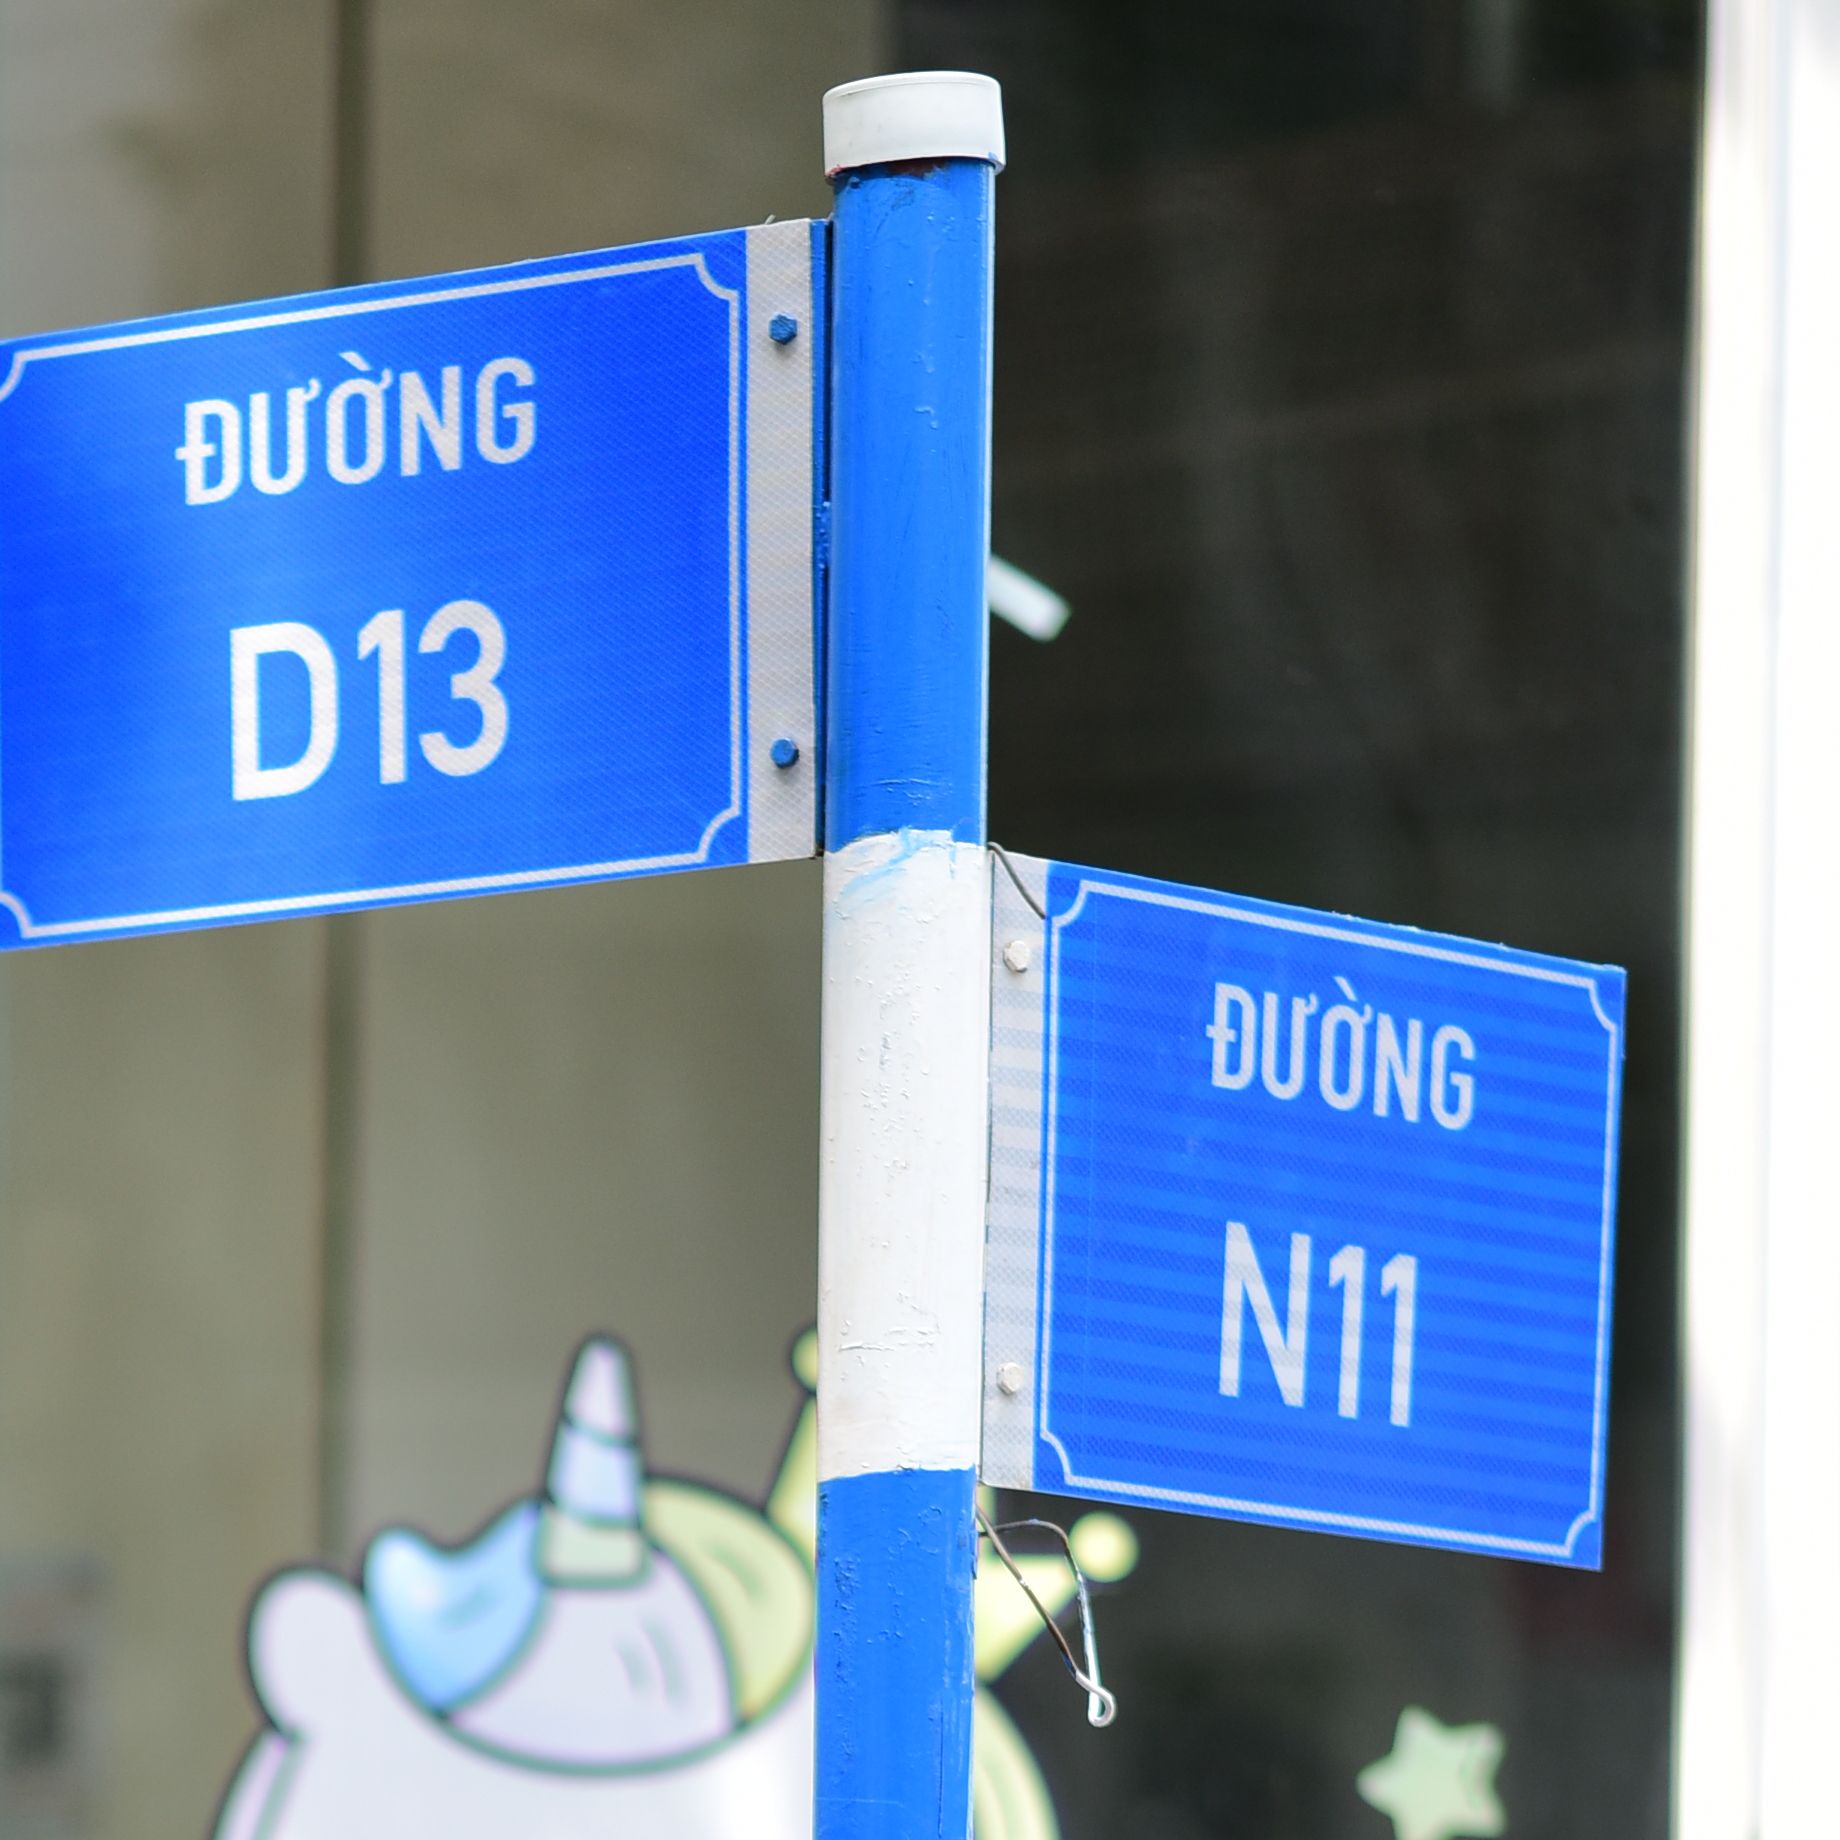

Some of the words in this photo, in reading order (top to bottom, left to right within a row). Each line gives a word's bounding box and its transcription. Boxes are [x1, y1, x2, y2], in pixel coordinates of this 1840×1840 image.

[176, 352, 535, 505] ĐƯỜNG
[229, 600, 508, 800] D13
[1206, 976, 1477, 1130] ĐƯỜNG
[1219, 1221, 1417, 1428] N11
